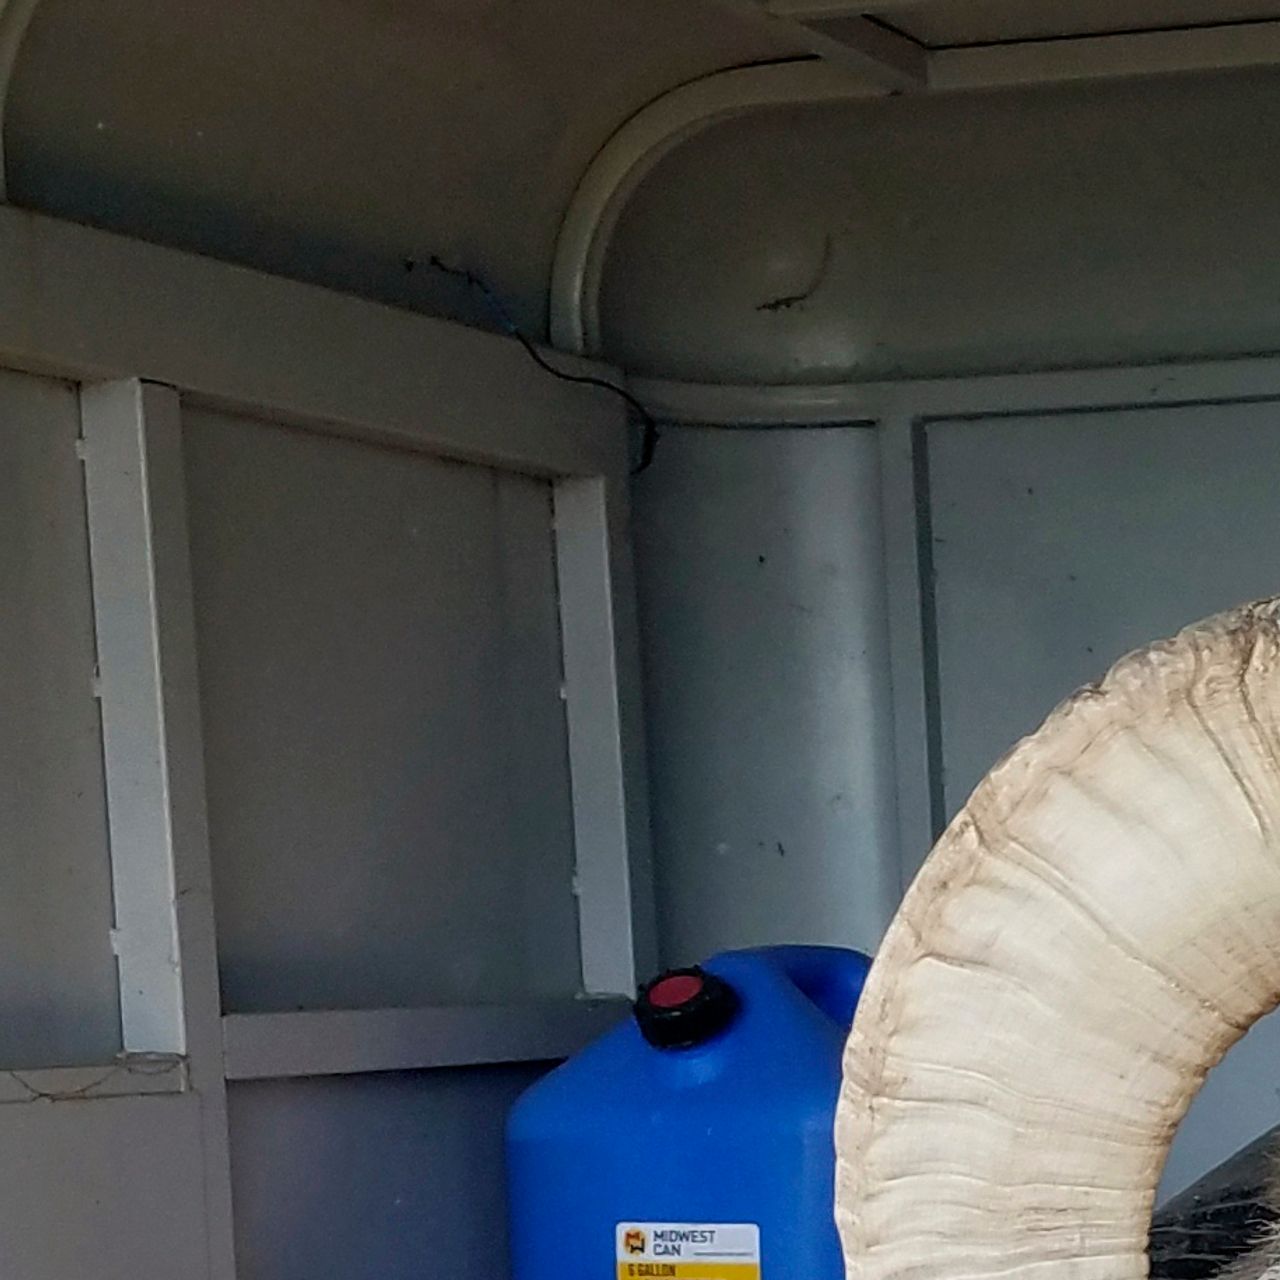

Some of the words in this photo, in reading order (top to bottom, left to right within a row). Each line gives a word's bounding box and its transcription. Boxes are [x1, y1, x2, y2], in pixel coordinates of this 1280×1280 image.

[653, 1230, 716, 1243] MIDWEST
[653, 1243, 681, 1256] CAN
[638, 1264, 676, 1276] GALLON
